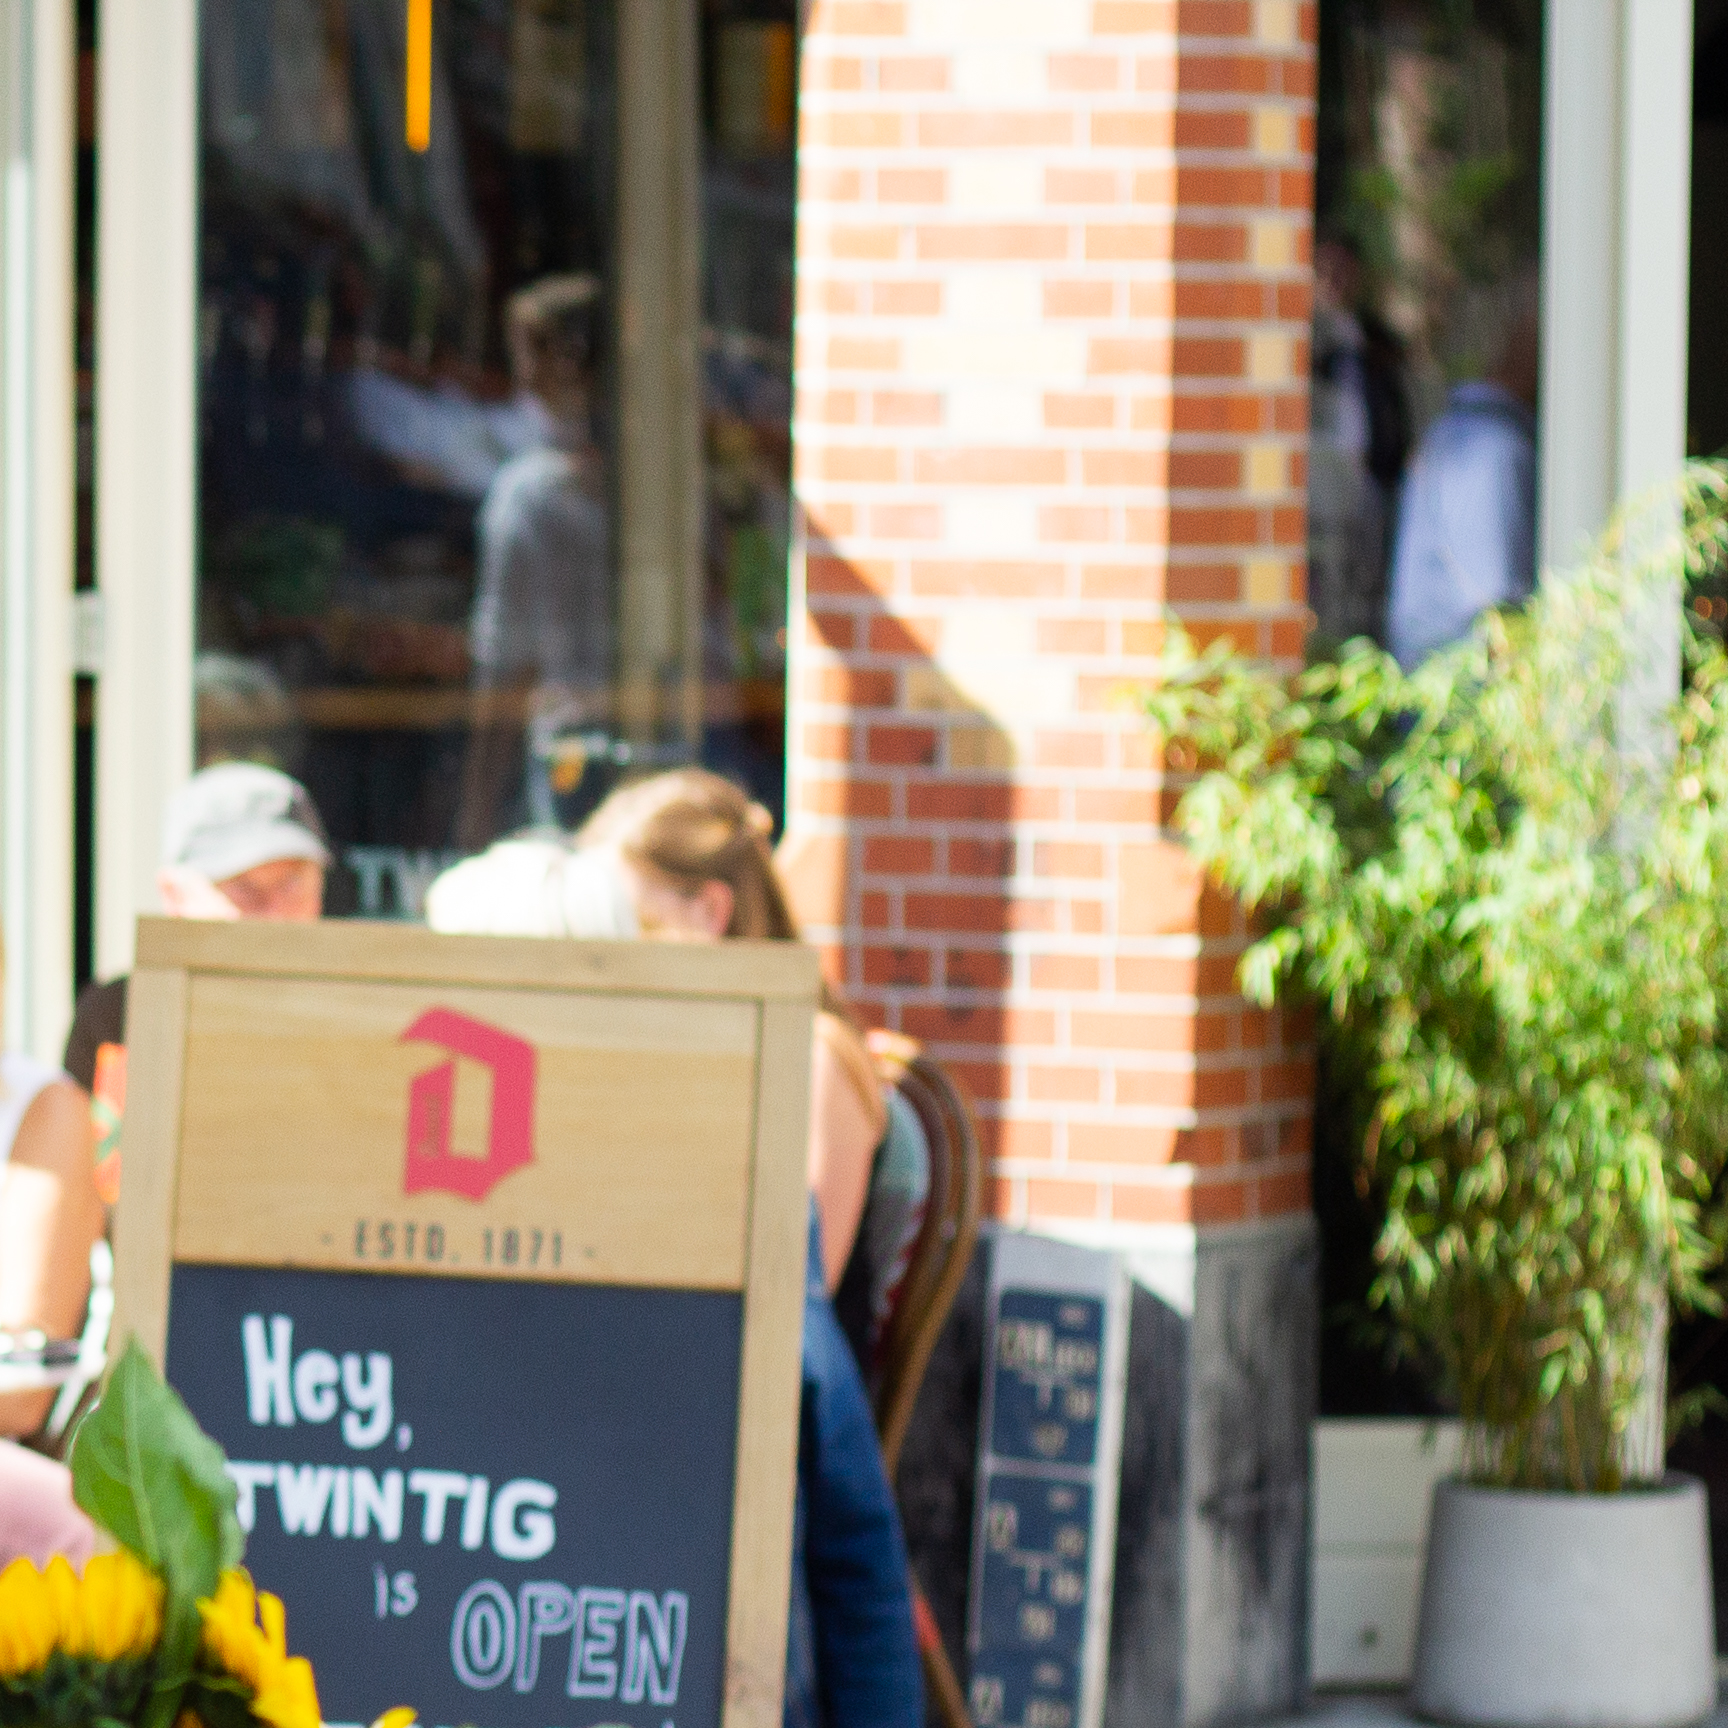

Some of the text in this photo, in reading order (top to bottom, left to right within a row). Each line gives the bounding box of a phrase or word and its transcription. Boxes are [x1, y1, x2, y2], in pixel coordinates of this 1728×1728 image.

[242, 1313, 412, 1451] Hey,
[226, 1460, 559, 1561] TWINTIG
[451, 1579, 688, 1705] OPEN
